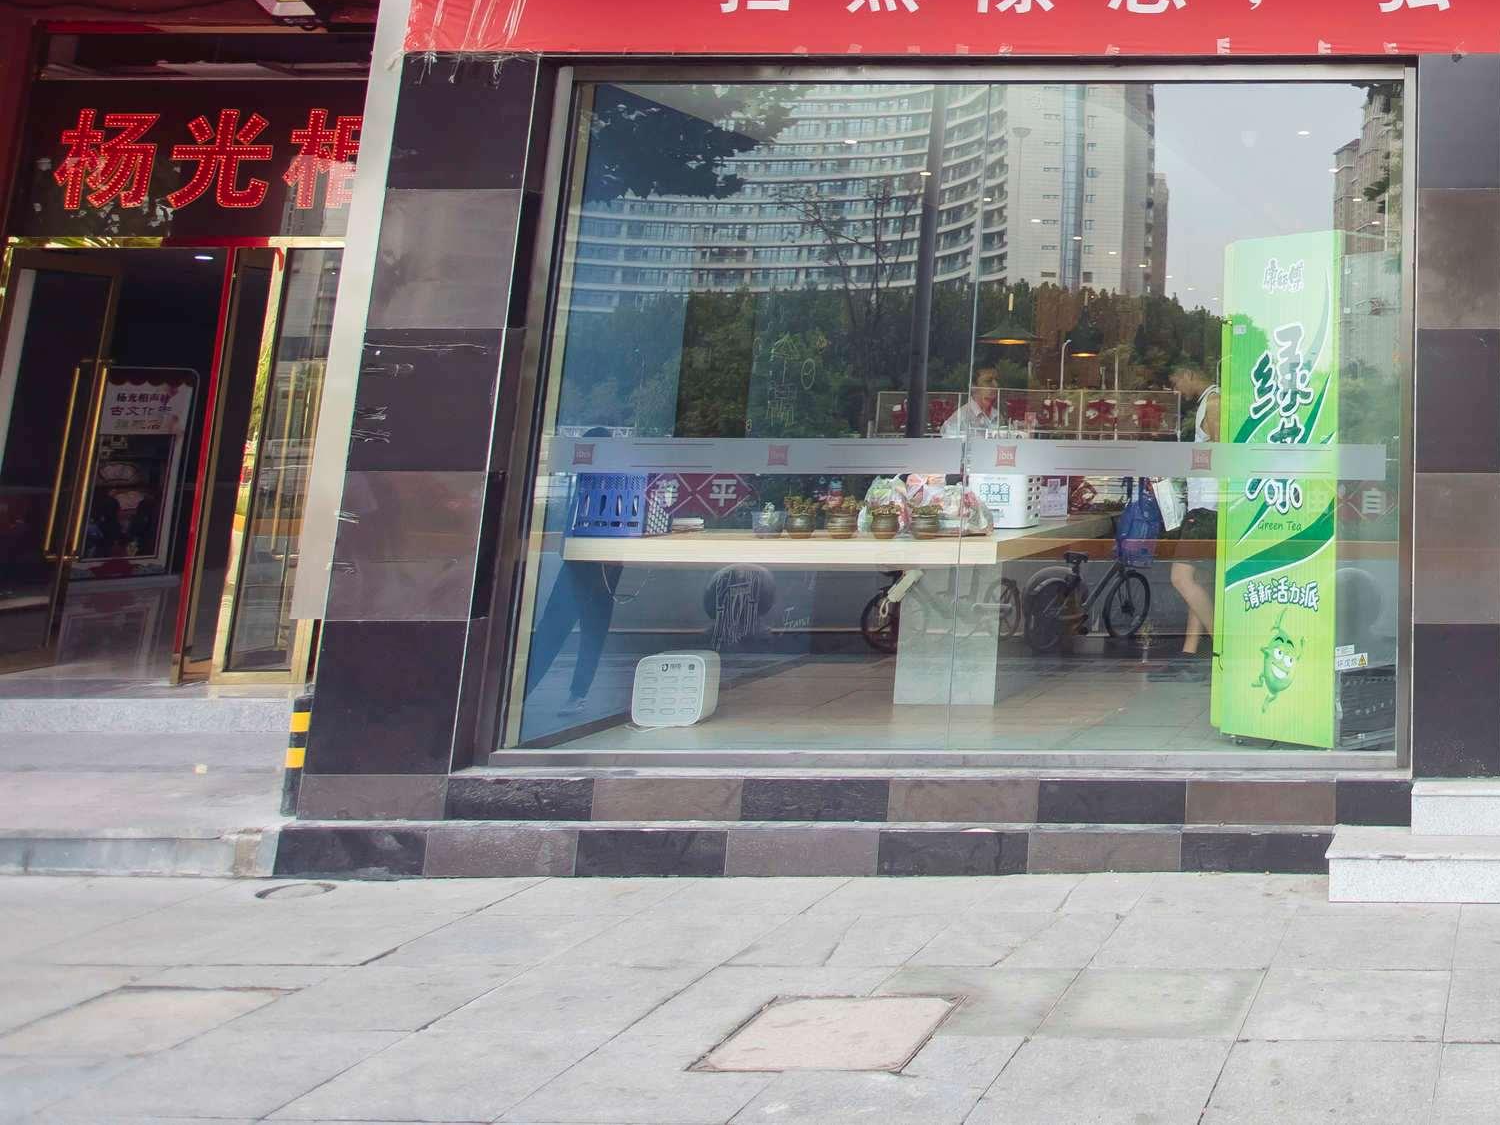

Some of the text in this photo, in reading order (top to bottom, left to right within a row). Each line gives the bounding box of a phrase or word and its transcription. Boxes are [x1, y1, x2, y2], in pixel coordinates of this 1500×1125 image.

[1257, 520, 1302, 531] Green Tea
[1244, 576, 1320, 611] 清新活力派
